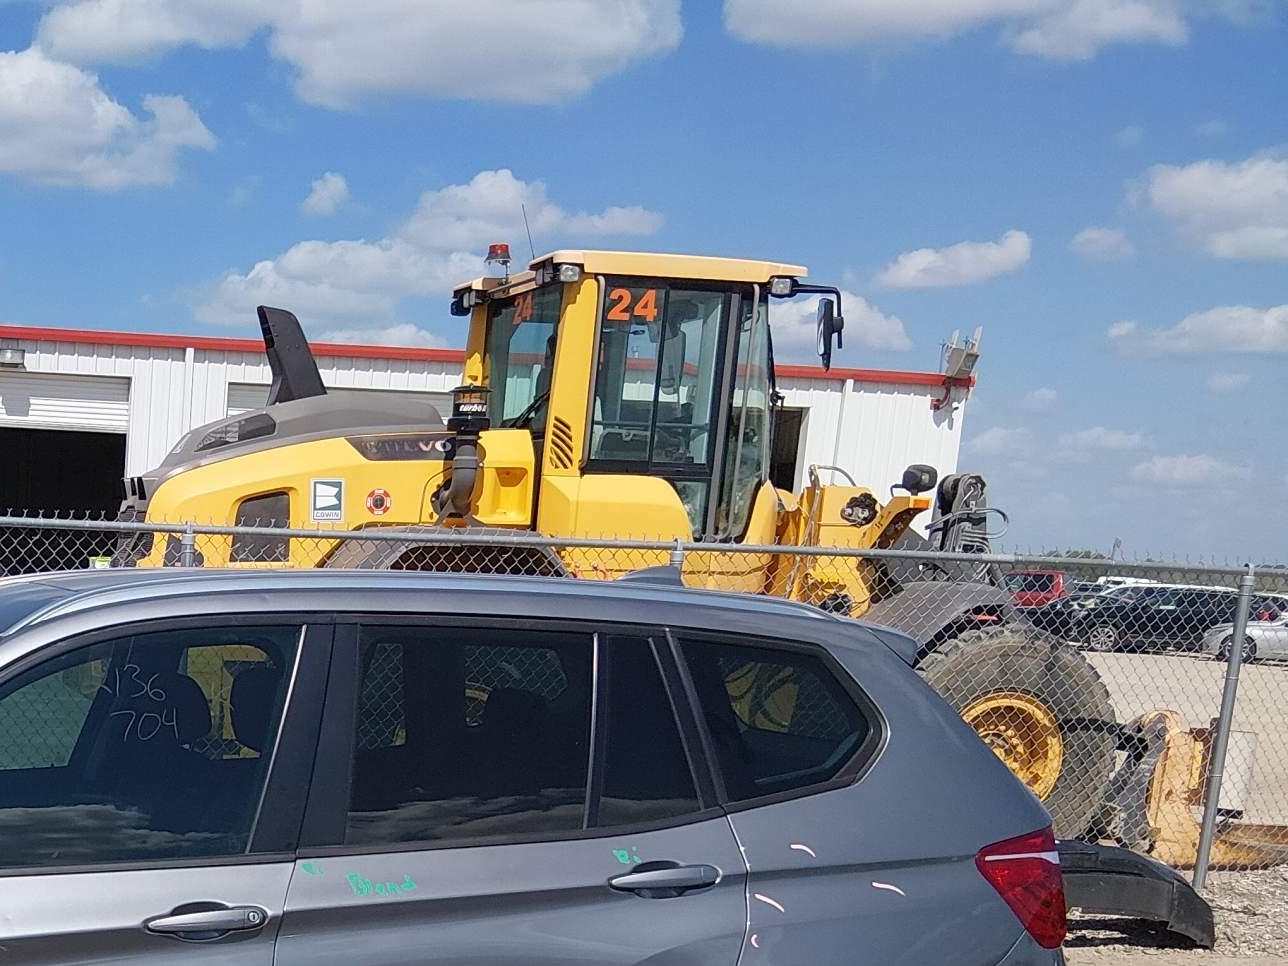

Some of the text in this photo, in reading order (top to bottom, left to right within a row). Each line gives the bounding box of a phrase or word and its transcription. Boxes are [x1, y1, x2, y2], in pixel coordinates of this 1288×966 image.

[513, 292, 533, 325] 24
[606, 288, 658, 321] 24
[110, 707, 179, 741] 704
